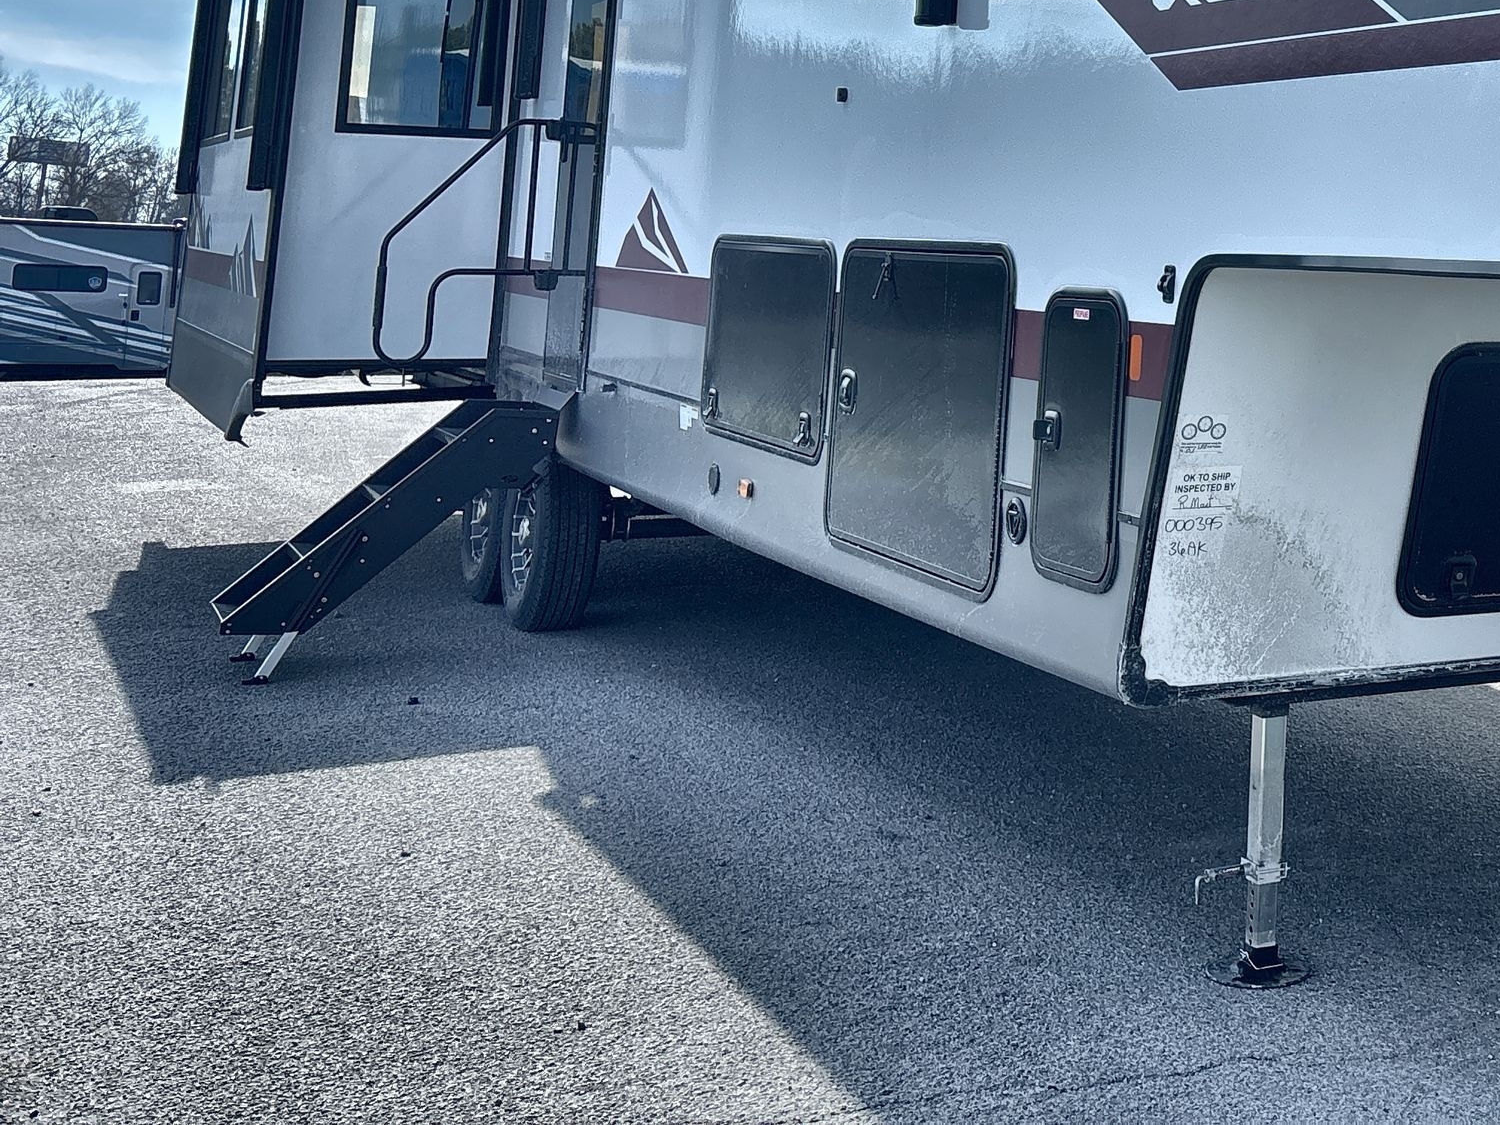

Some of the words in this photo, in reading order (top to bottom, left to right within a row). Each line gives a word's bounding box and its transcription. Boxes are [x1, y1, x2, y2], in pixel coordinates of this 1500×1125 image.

[1183, 474, 1196, 482] OK
[1199, 473, 1209, 482] TO
[1211, 472, 1231, 481] SHIP
[1175, 484, 1222, 493] INSPECTED
[1224, 483, 1236, 491] BY
[1165, 516, 1223, 533] 000395
